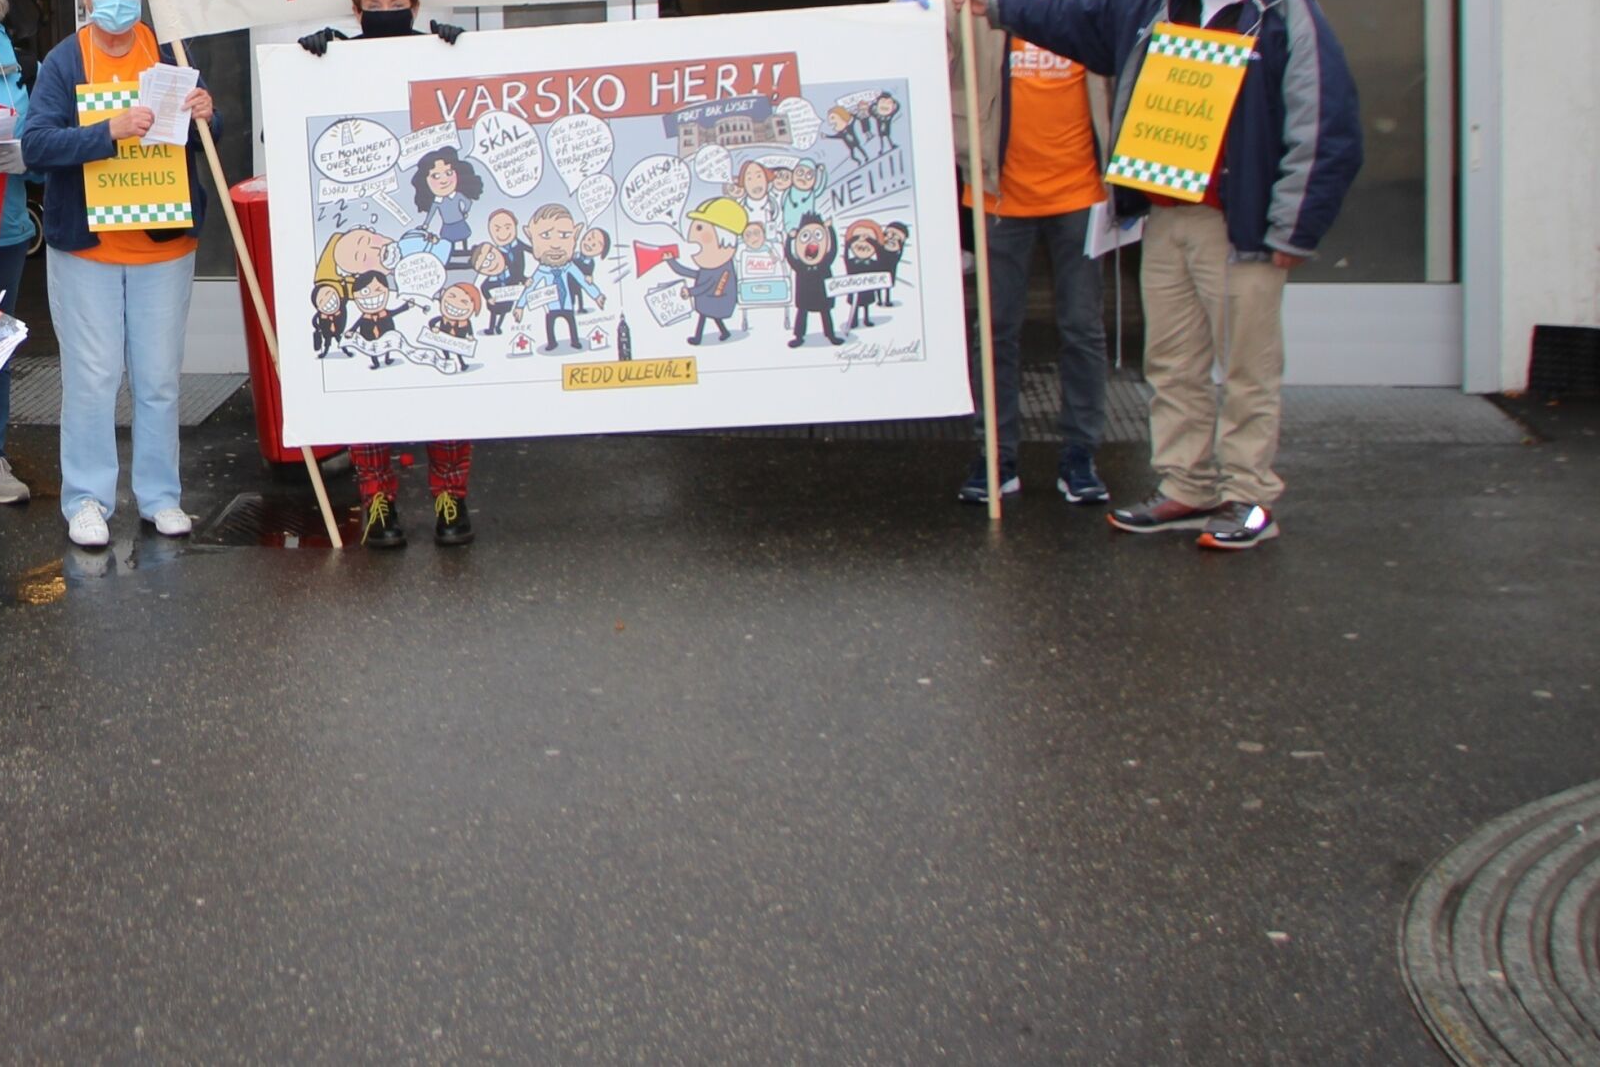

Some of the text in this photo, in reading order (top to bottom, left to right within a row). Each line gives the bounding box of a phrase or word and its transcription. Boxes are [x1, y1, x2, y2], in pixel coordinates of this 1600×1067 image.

[1009, 50, 1071, 69] REDD
[1167, 67, 1213, 89] REDD
[436, 63, 785, 122] VARSKO HER!!
[725, 99, 757, 112] LYSET
[1144, 93, 1214, 121] ULLEVÅL
[482, 116, 500, 134] VI
[569, 119, 588, 130] KAN
[479, 125, 529, 154] SKAL
[556, 124, 602, 145] VEL STOLE
[1133, 122, 1209, 151] SYKEHUS
[320, 138, 393, 162] ET MONUMENT
[555, 143, 569, 157] PÅ
[326, 151, 382, 171] OVER MEG
[98, 171, 176, 188] SYKEHUS
[828, 274, 887, 292] ØKONOMER
[650, 288, 677, 306] PLAN
[569, 366, 613, 385] REDD
